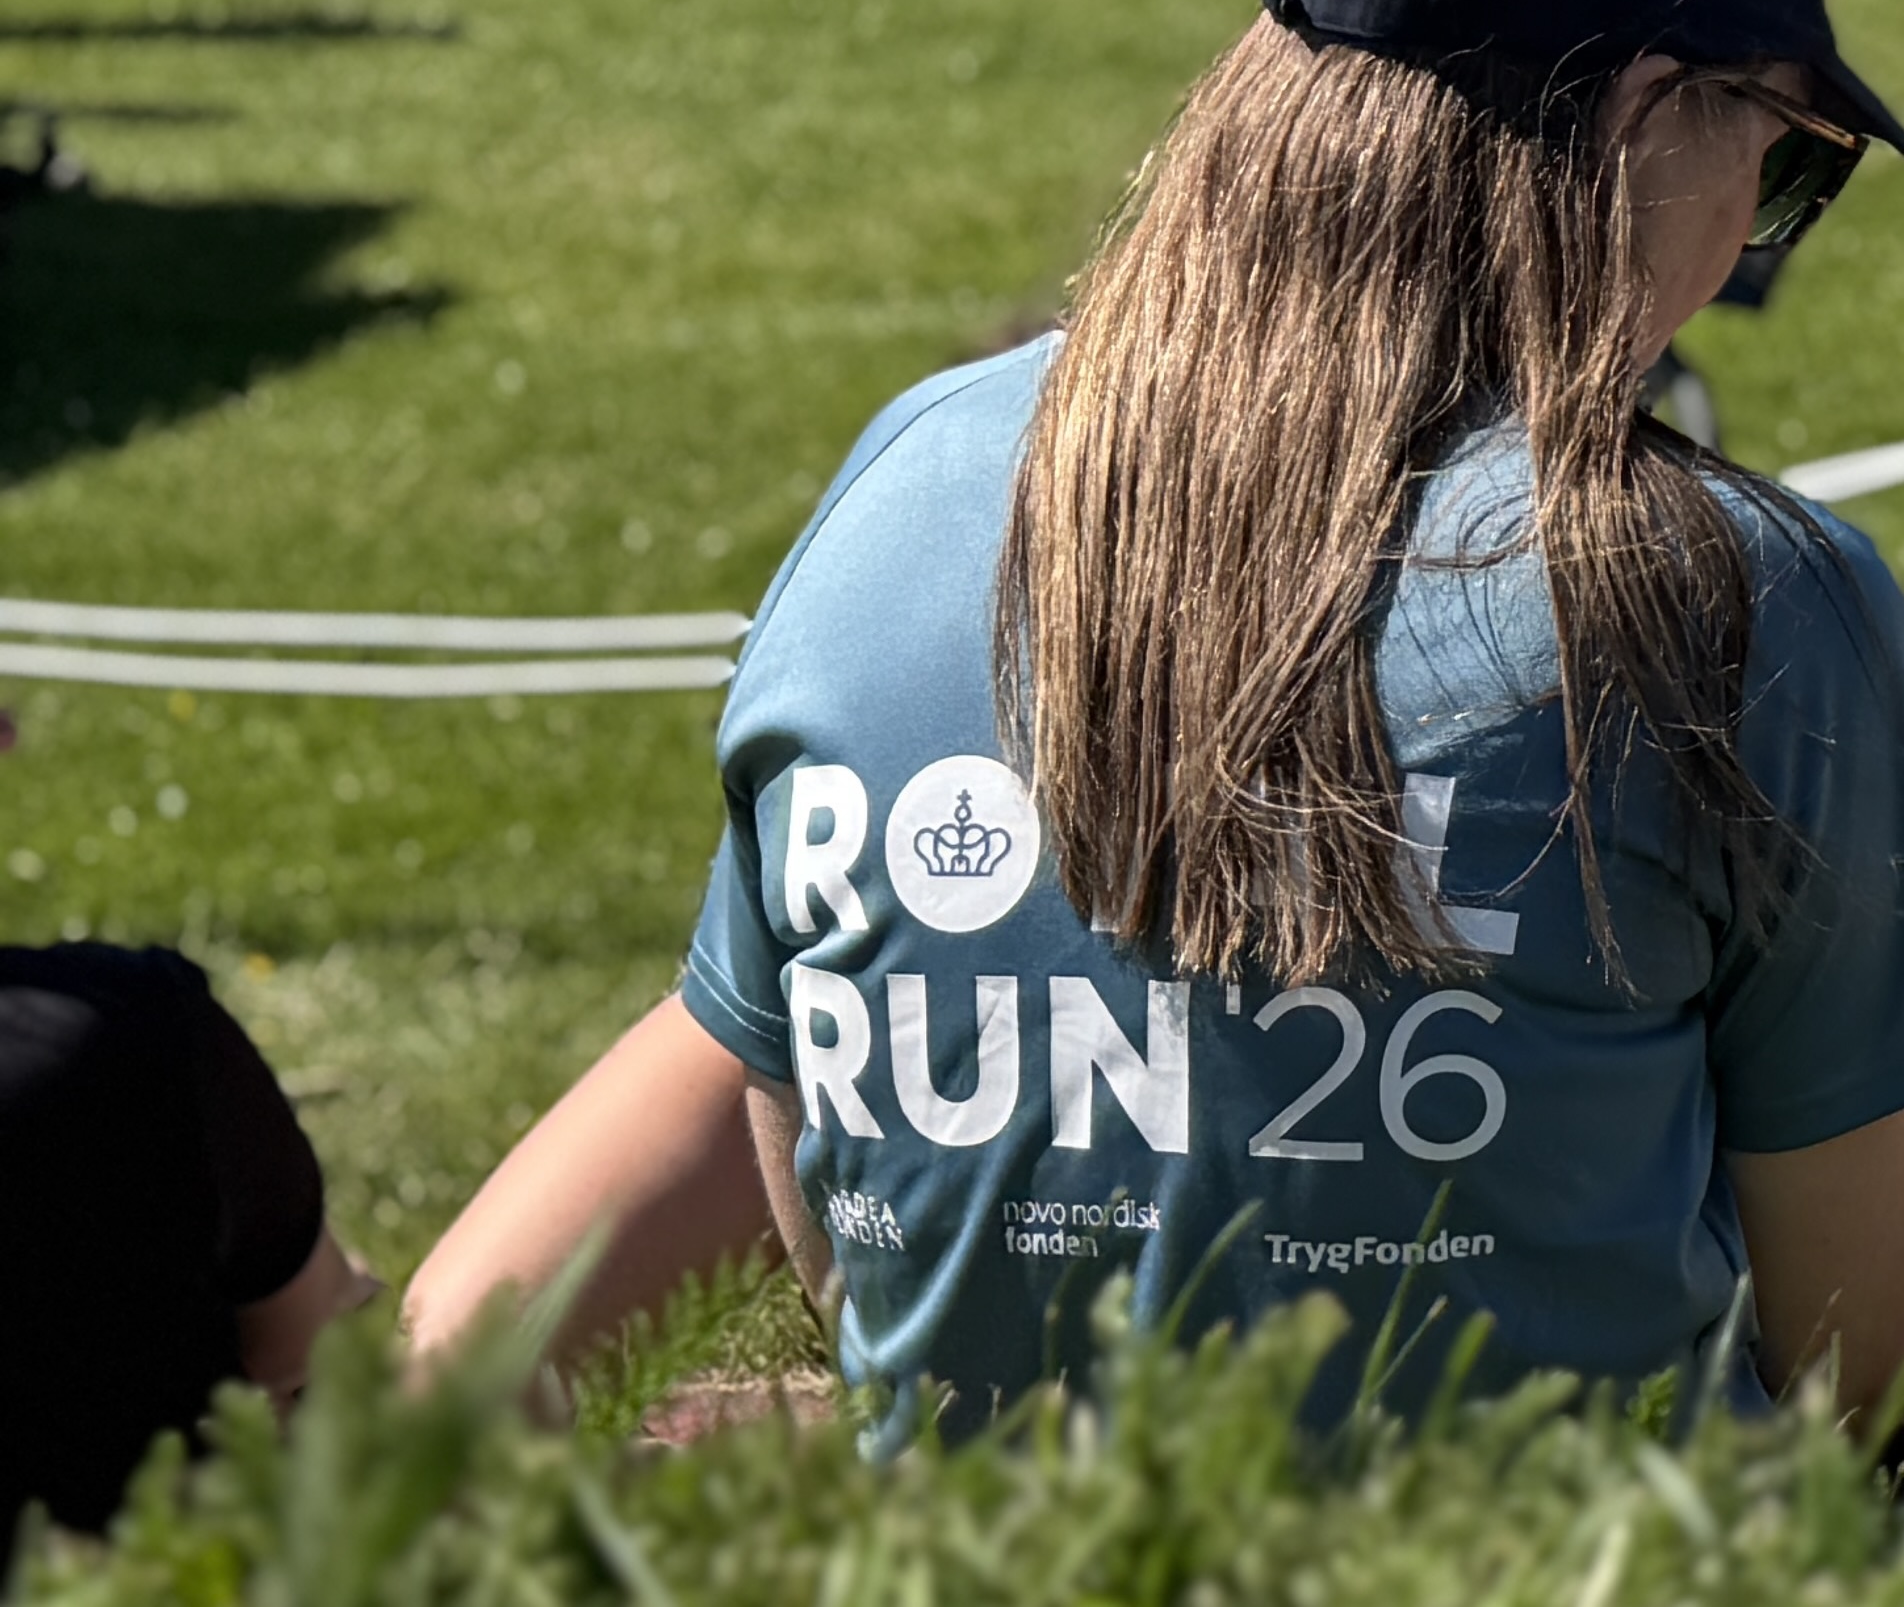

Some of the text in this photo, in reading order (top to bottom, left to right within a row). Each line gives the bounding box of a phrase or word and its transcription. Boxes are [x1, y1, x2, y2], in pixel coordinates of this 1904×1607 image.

[785, 756, 1520, 955] ROL
[1004, 1201, 1066, 1225] novo
[1005, 1226, 1098, 1257] fonden
[1264, 1229, 1495, 1273] TrygFonden
